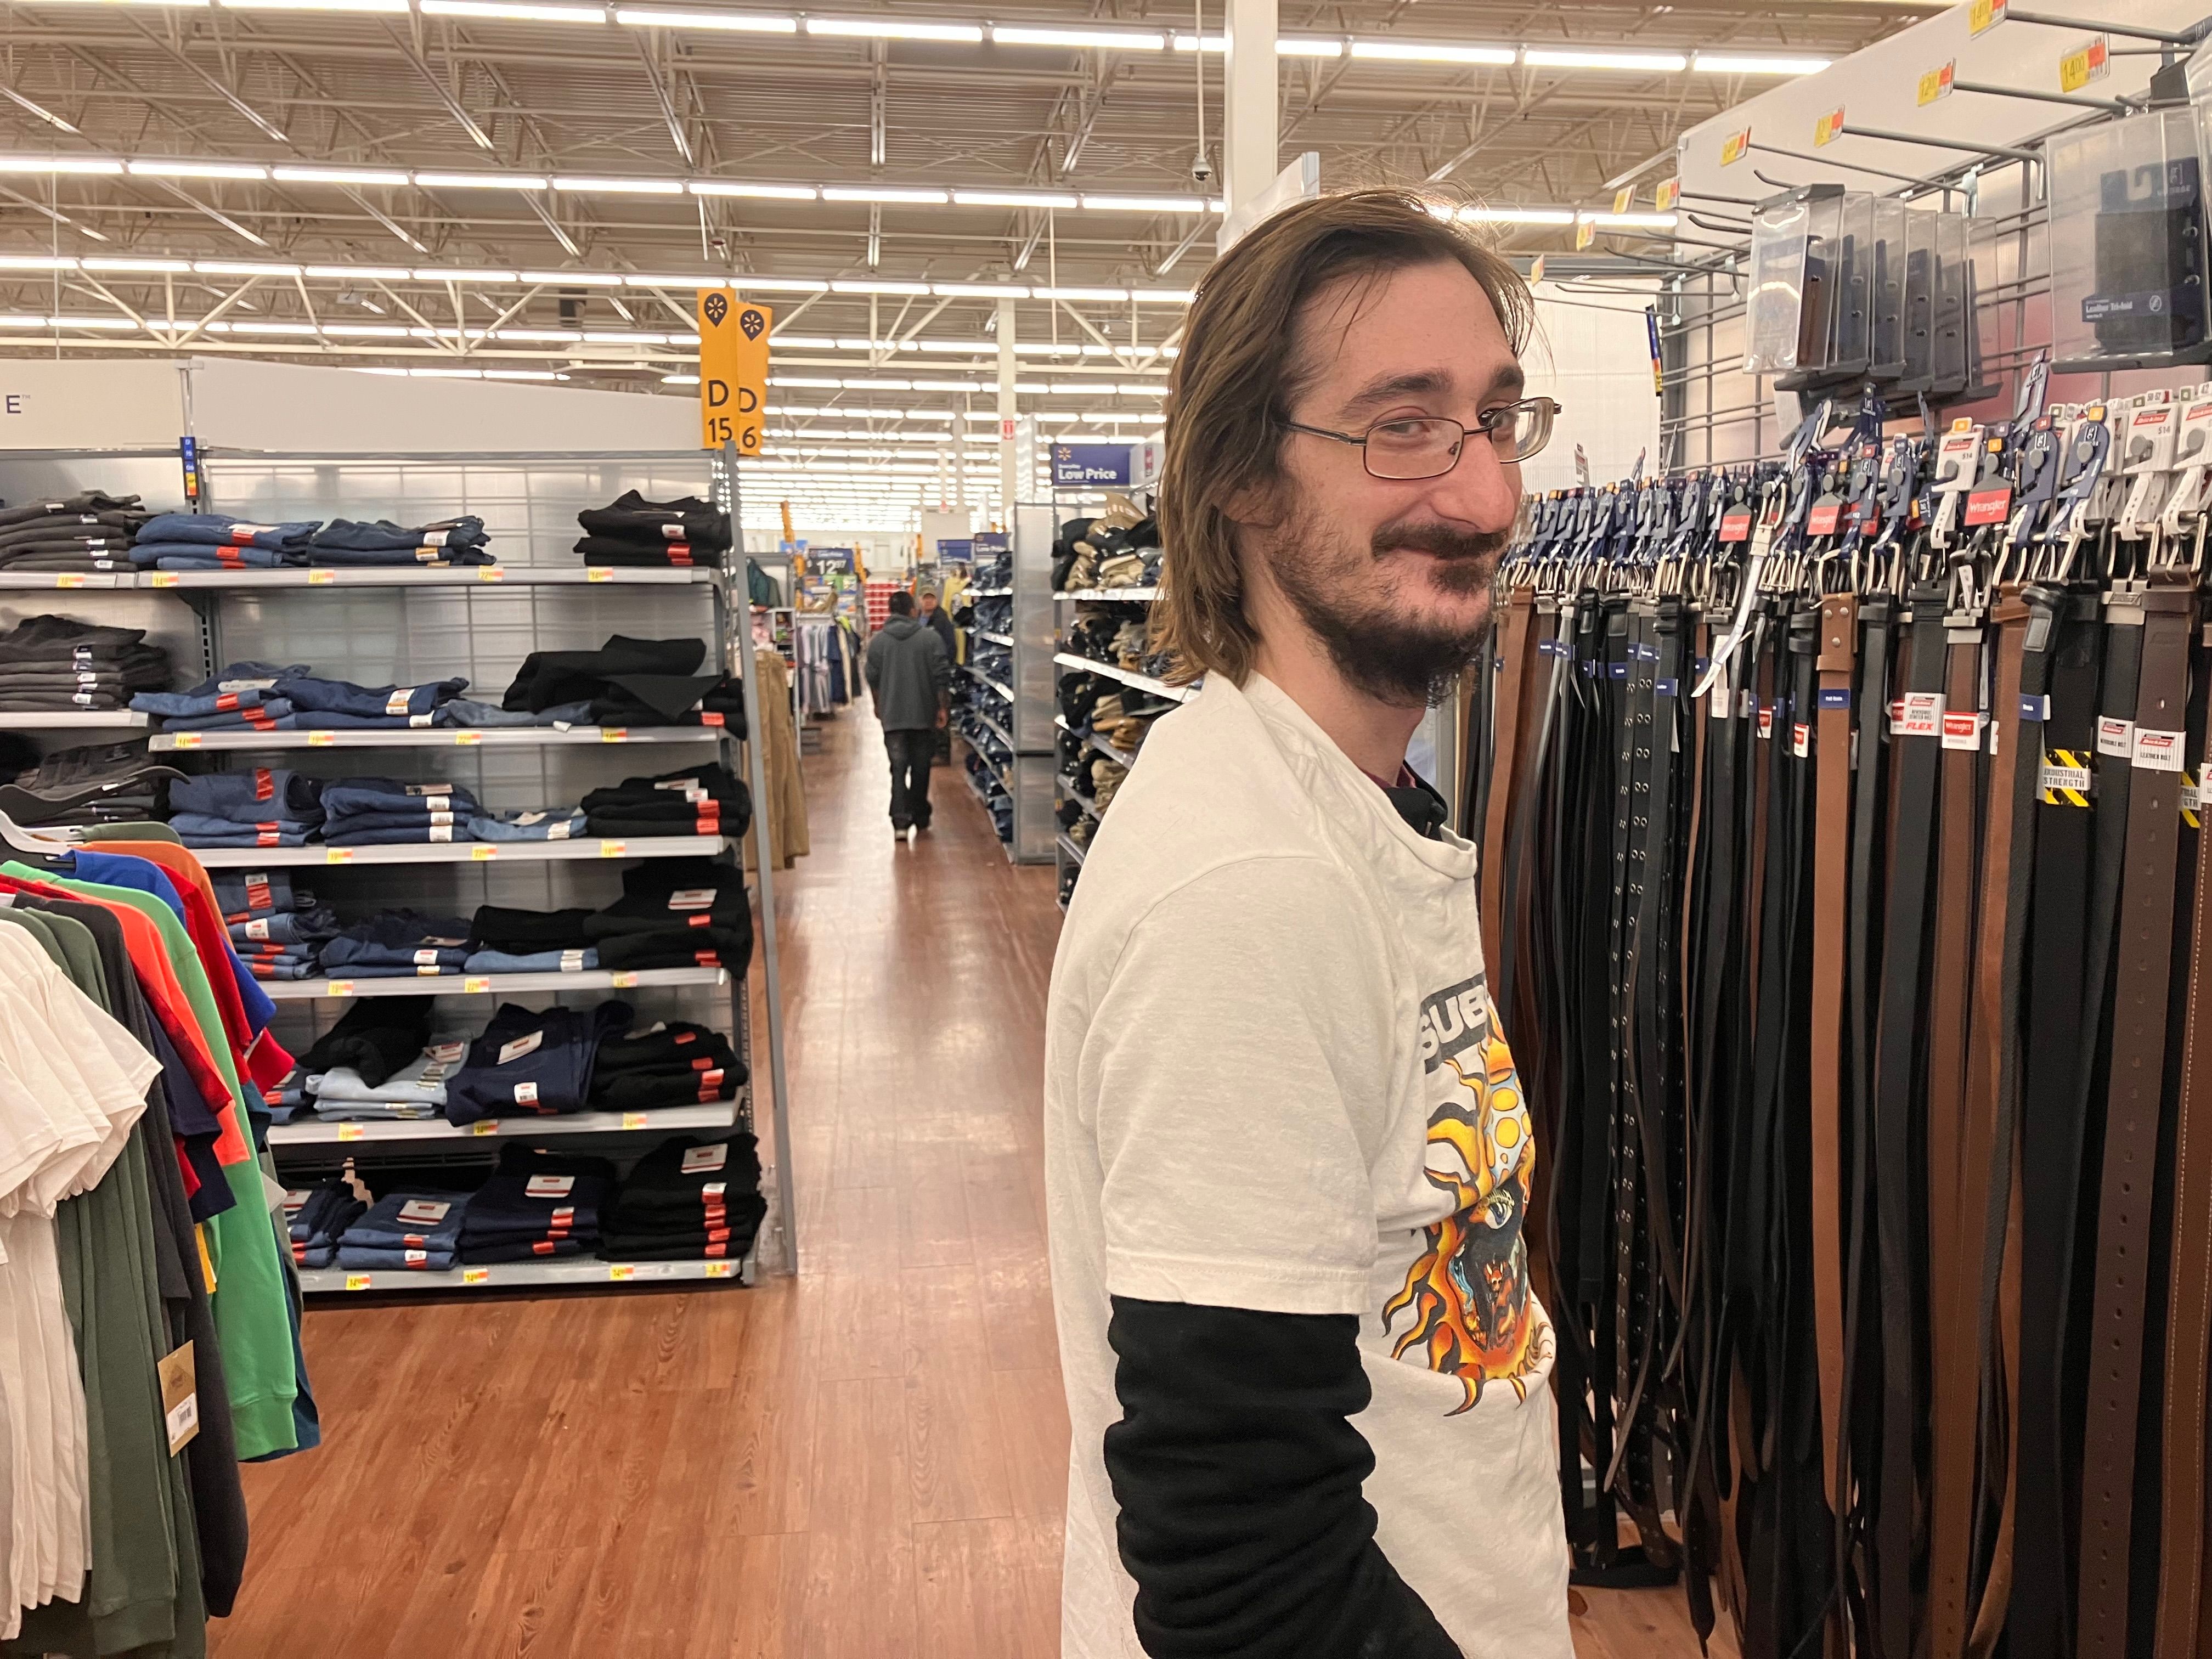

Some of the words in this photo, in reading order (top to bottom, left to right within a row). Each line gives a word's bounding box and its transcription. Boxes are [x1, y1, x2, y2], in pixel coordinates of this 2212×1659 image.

[2063, 55, 2085, 84] 1400
[708, 380, 729, 407] D
[739, 387, 757, 413] D
[708, 417, 732, 442] 15
[742, 426, 757, 449] 6
[1058, 469, 1084, 480] Low
[1086, 467, 1118, 480] Price
[1970, 500, 2006, 515] Wrangler
[1906, 722, 1934, 730] FLEX
[2044, 768, 2085, 778] INDUSTRIAL
[2044, 777, 2085, 788] STRENGTH
[1420, 984, 1488, 1060] SUB
